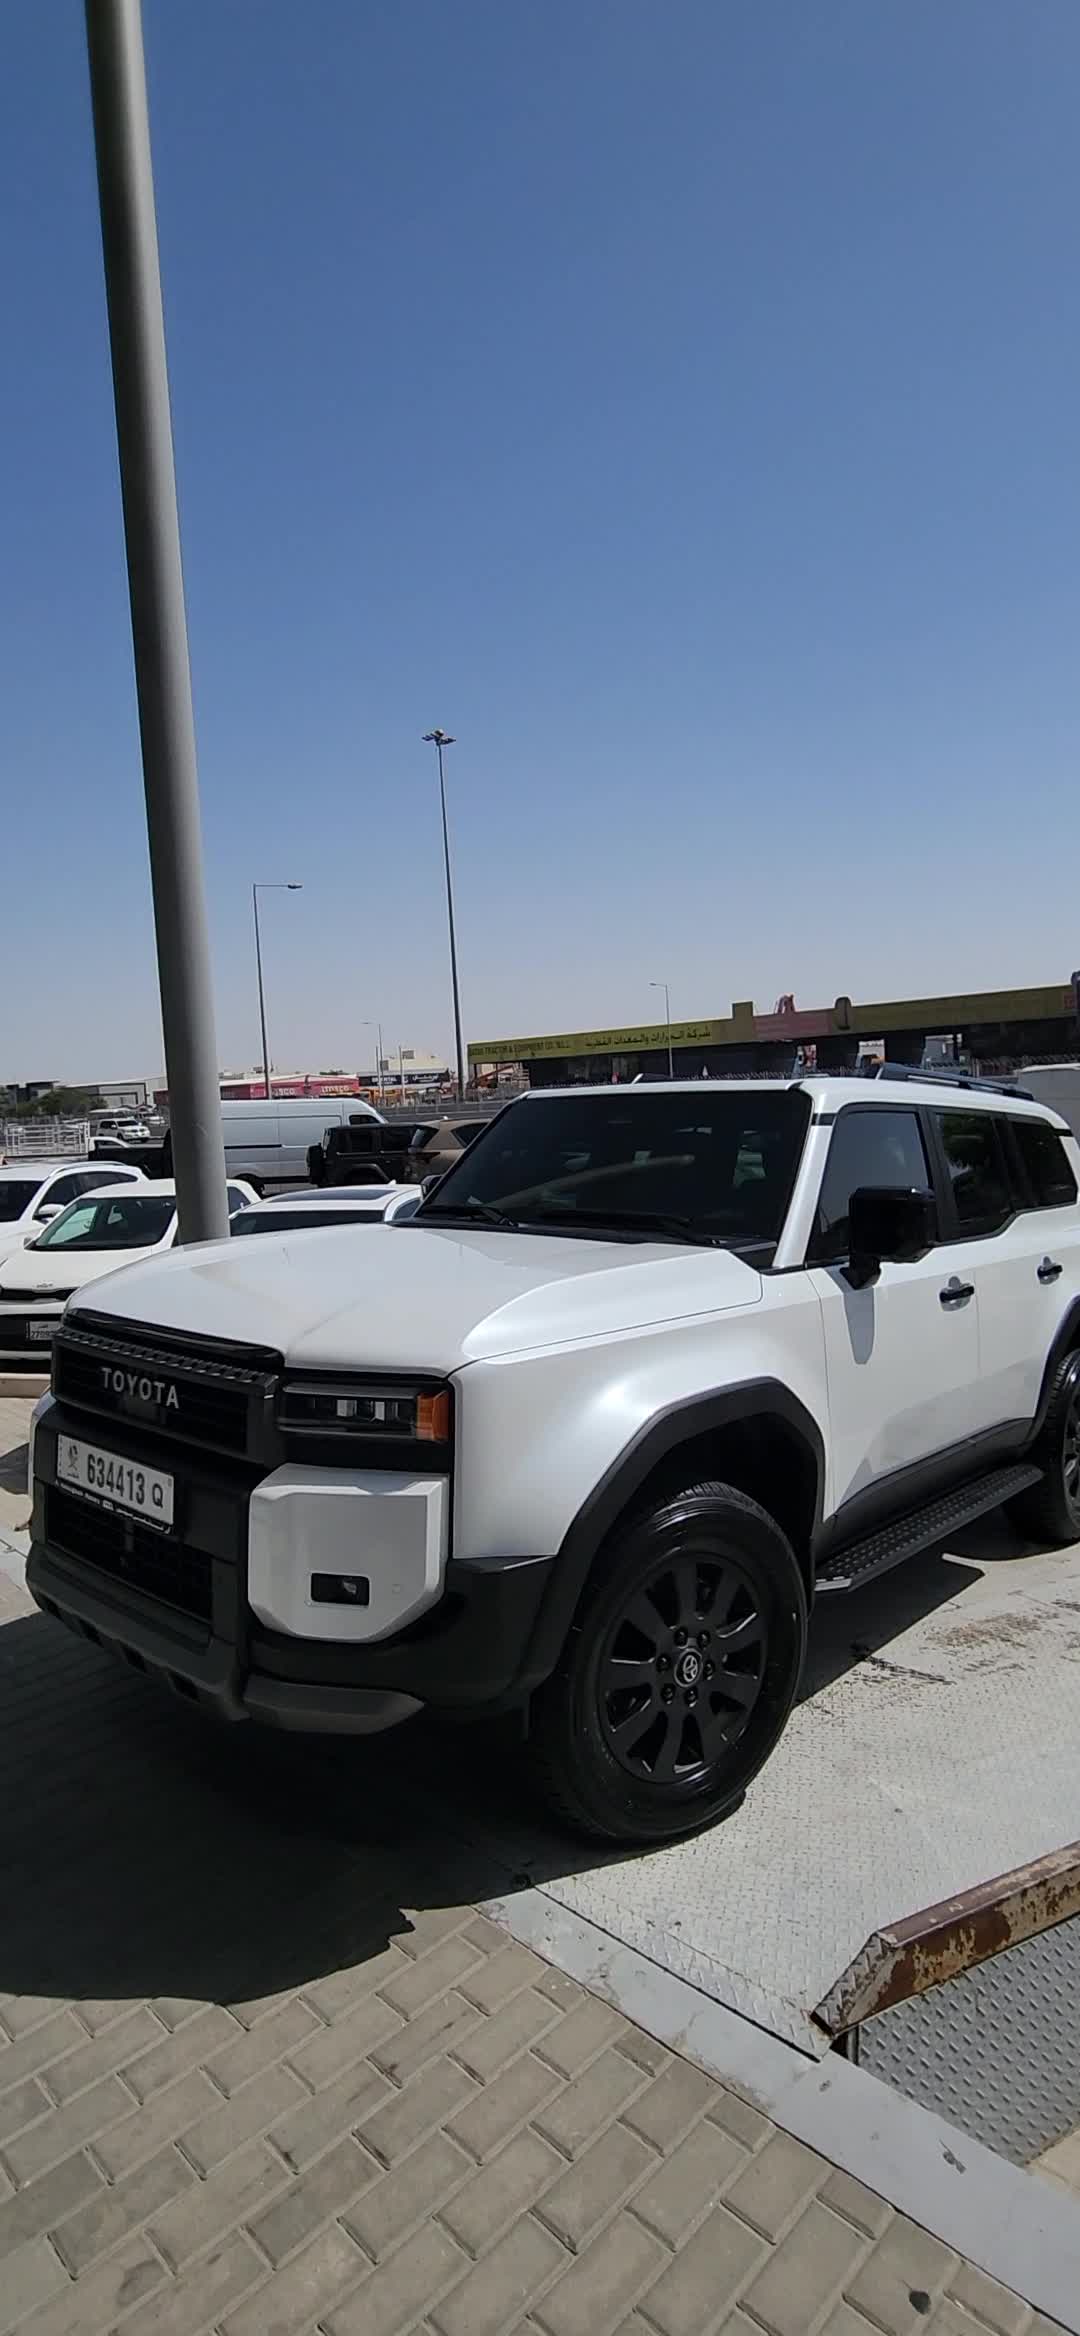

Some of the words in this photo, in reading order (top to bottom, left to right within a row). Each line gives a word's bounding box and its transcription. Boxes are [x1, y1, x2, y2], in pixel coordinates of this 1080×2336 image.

[101, 1367, 180, 1409] TOYOTA
[87, 1453, 145, 1505] 634413
[152, 1483, 164, 1509] Q
